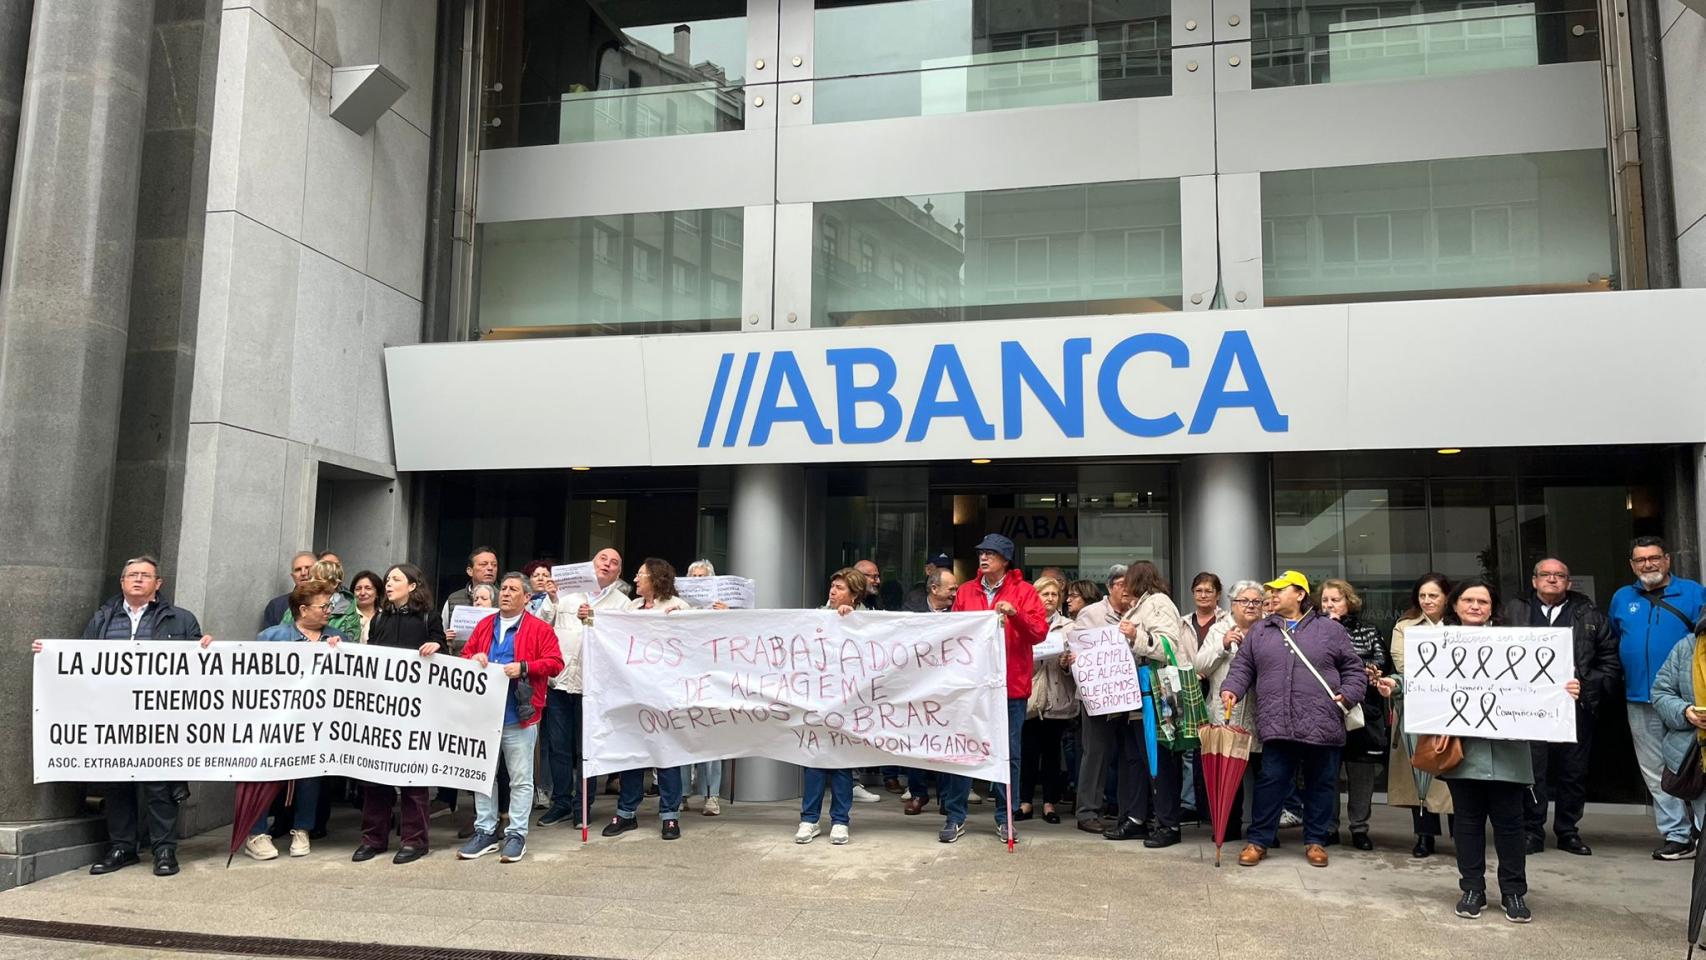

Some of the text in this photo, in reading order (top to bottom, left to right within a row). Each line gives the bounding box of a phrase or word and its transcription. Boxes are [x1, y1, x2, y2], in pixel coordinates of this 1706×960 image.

[626, 627, 973, 677] LOS TRABAJADORES
[58, 652, 488, 696] LA JUSTICIA YA HABLO, FALTAN LOS PAGOS
[678, 671, 889, 705] DE ALFAGEME
[1078, 669, 1095, 683] DE
[1080, 678, 1135, 698] QUEREMOS
[132, 688, 422, 718] TENEMOS NUESTROS DERECHOS
[638, 700, 949, 734] QUEREMOS COBRAR
[50, 721, 487, 760] QUE TAMBIEN SON LA NAVE Y SOLARES EN VENTA
[793, 729, 819, 749] YA
[919, 733, 942, 755] 16
[944, 732, 991, 756] AÑOS
[48, 757, 81, 768] ASOC.
[84, 757, 183, 768] EXTRABAJADORES
[187, 757, 201, 767] DE
[204, 757, 258, 768] BERNARDO
[260, 754, 316, 768] ALFAGEME
[357, 756, 428, 776] CONSTITUCIÓN)
[431, 766, 487, 782] G-21728256
